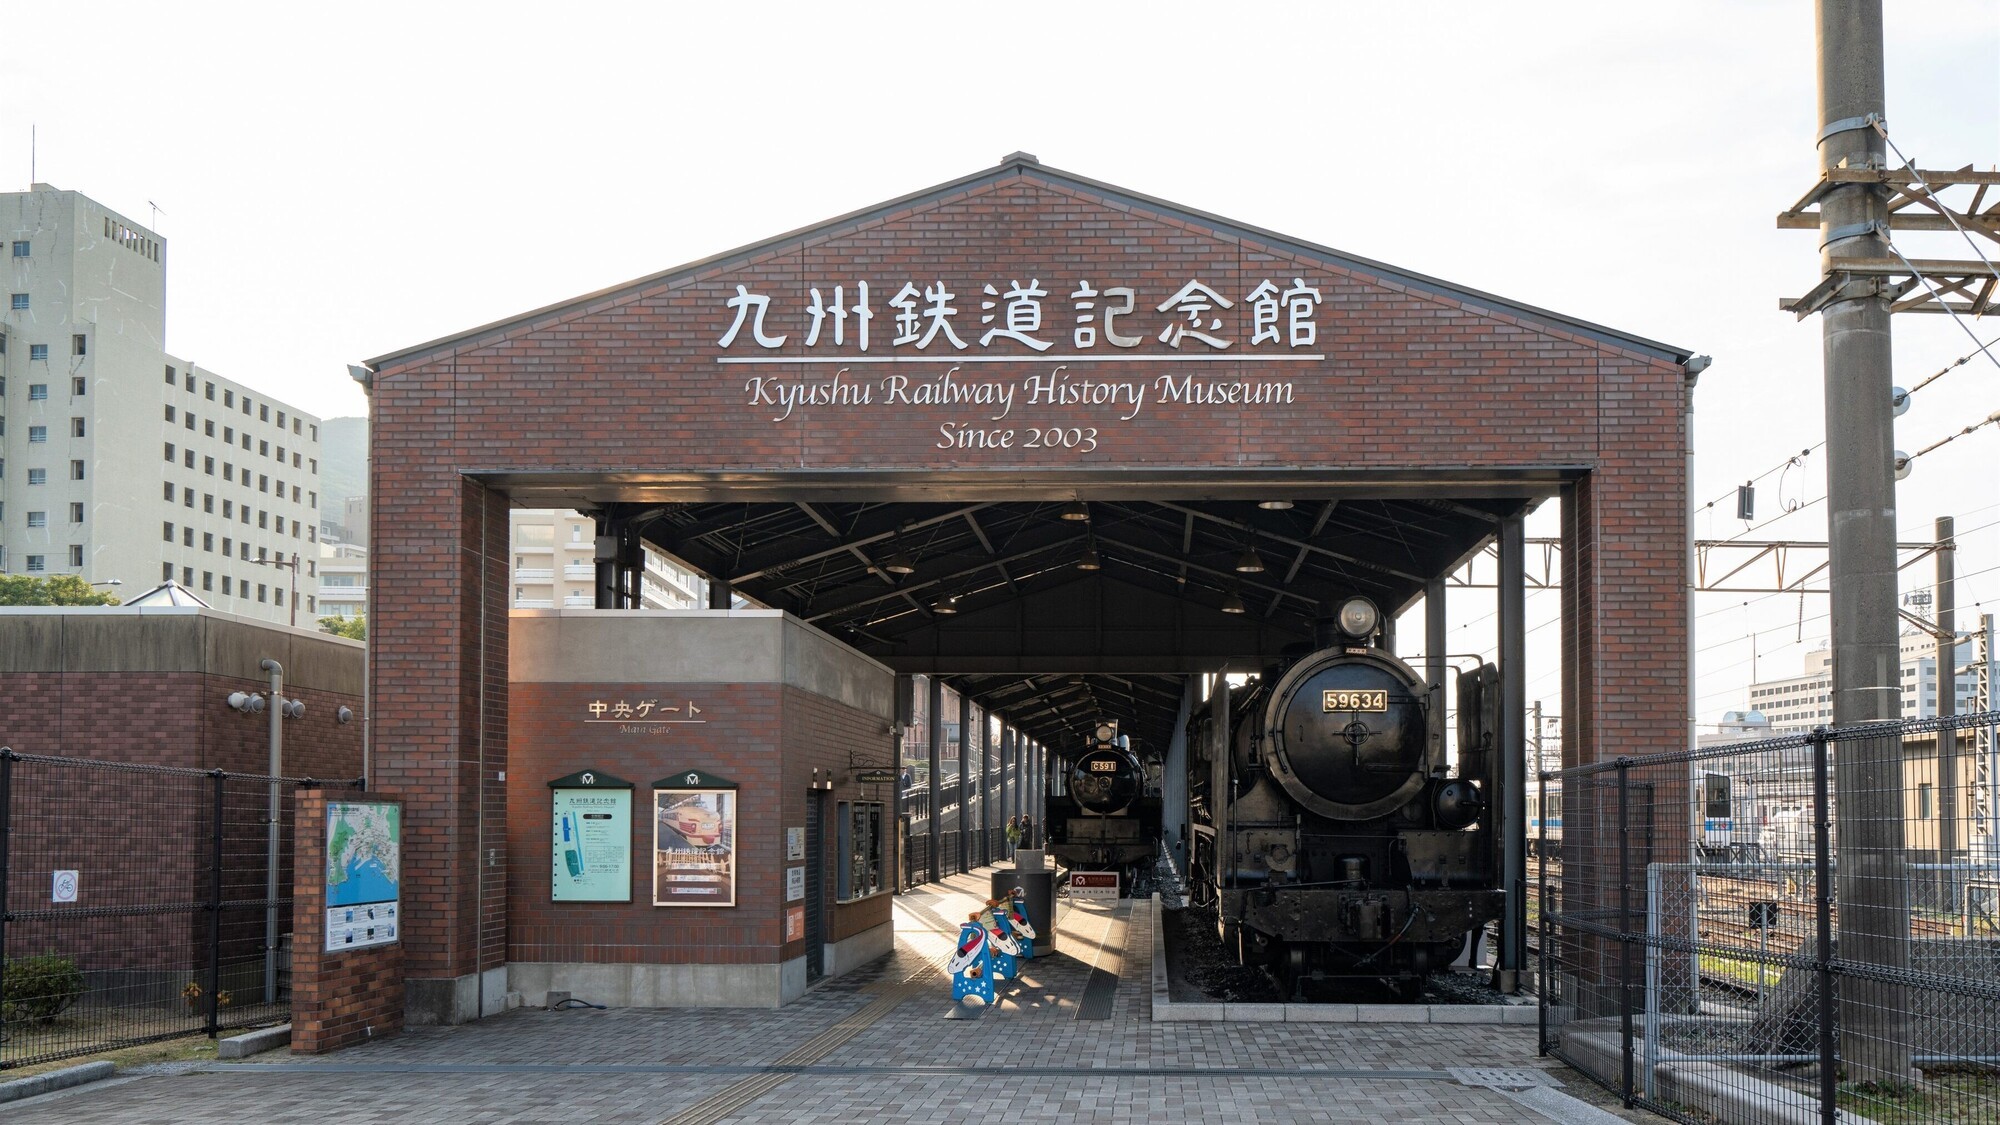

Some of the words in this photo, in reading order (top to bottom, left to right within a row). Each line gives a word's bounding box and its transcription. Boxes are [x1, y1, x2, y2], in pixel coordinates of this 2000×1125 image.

[717, 278, 1323, 351] 九州鉄道記念館
[745, 368, 873, 421] Kyushu
[881, 367, 1015, 420] Railway
[1023, 366, 1146, 421] History
[1154, 374, 1295, 406] Museum
[936, 421, 1014, 449] Since
[1023, 426, 1098, 453] 2003
[588, 699, 701, 719] 中央ゲート
[1327, 693, 1383, 708] 59634
[619, 724, 646, 735] Main
[649, 725, 671, 736] Gate
